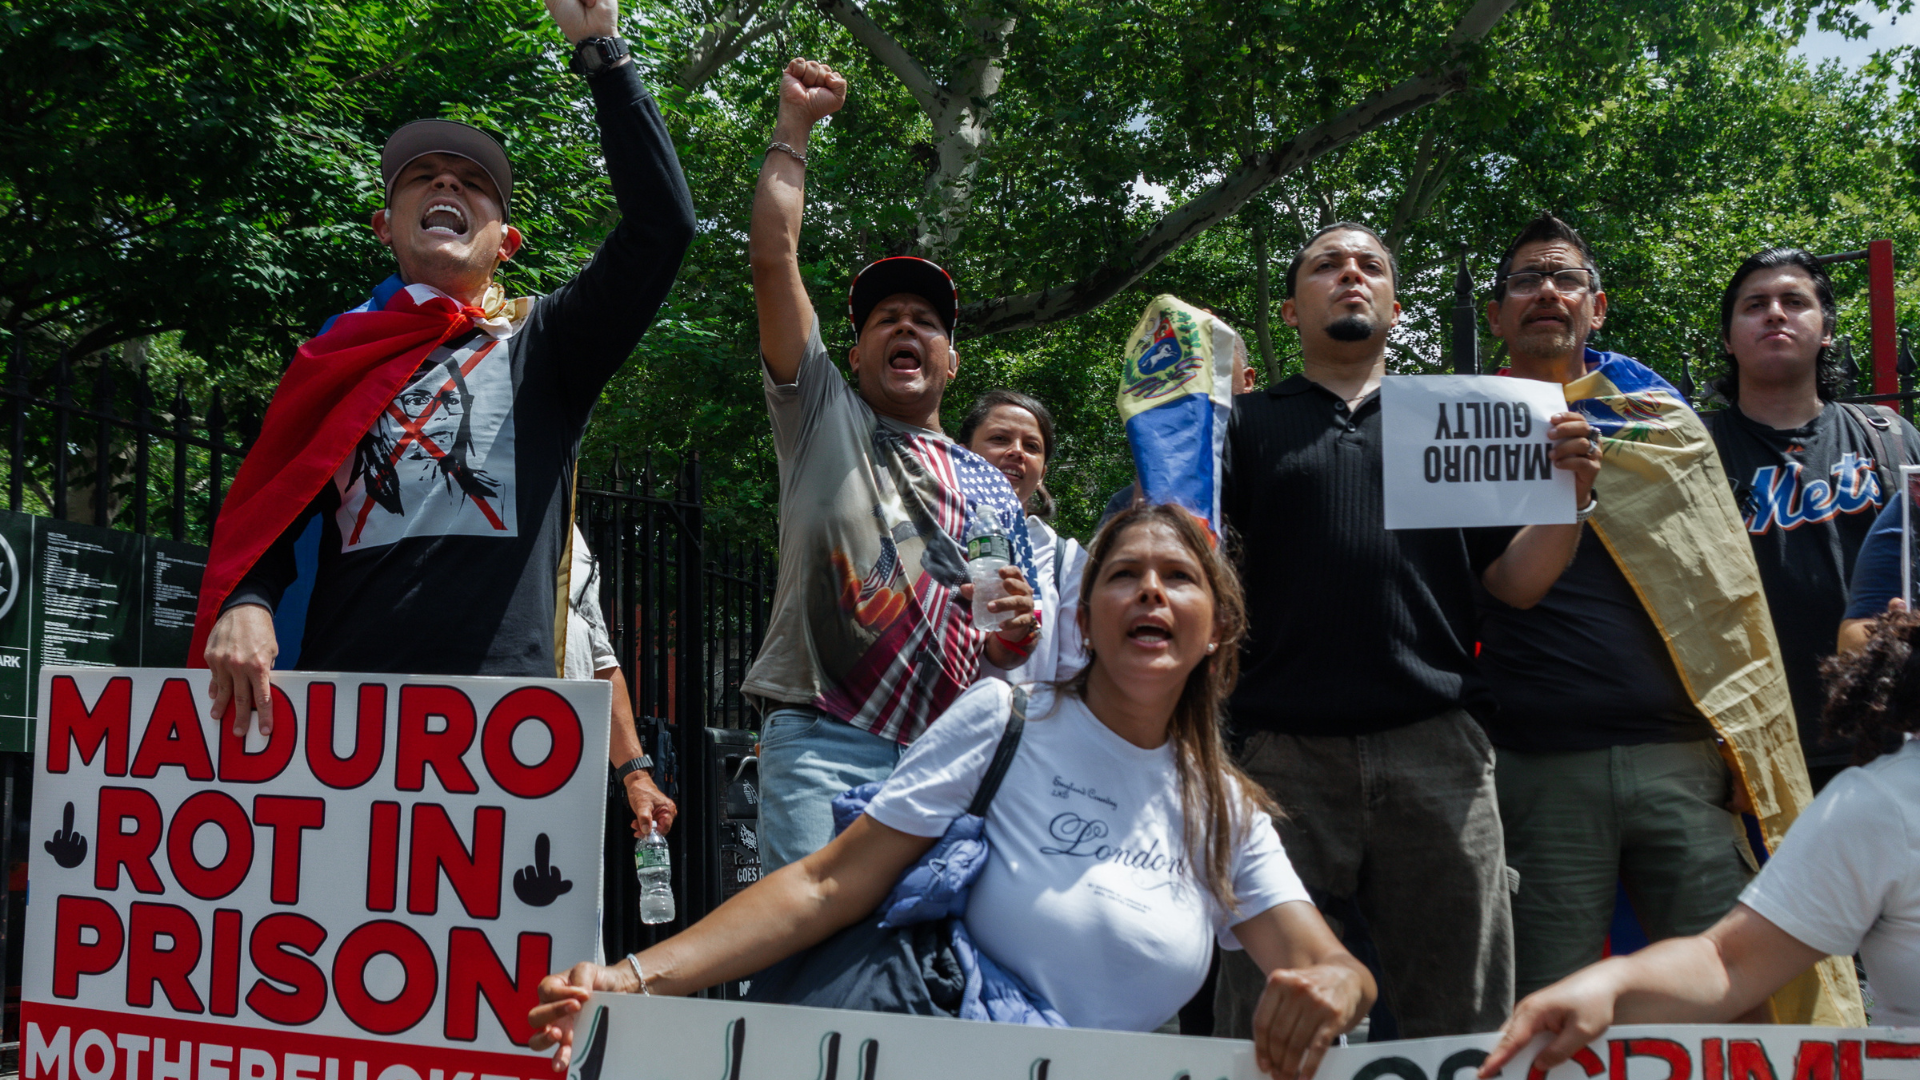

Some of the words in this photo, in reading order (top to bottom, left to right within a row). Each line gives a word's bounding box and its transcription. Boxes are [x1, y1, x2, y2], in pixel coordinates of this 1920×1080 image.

[1434, 401, 1532, 440] GUILTY
[1424, 443, 1552, 483] MADURO
[1744, 452, 1883, 535] Mets
[0, 654, 21, 669] ARK
[46, 675, 584, 799] MADURO
[94, 786, 325, 905] ROT
[366, 800, 506, 920] IN
[736, 867, 758, 883] GOES
[1039, 811, 1184, 876] London
[52, 894, 554, 1047] PRISON
